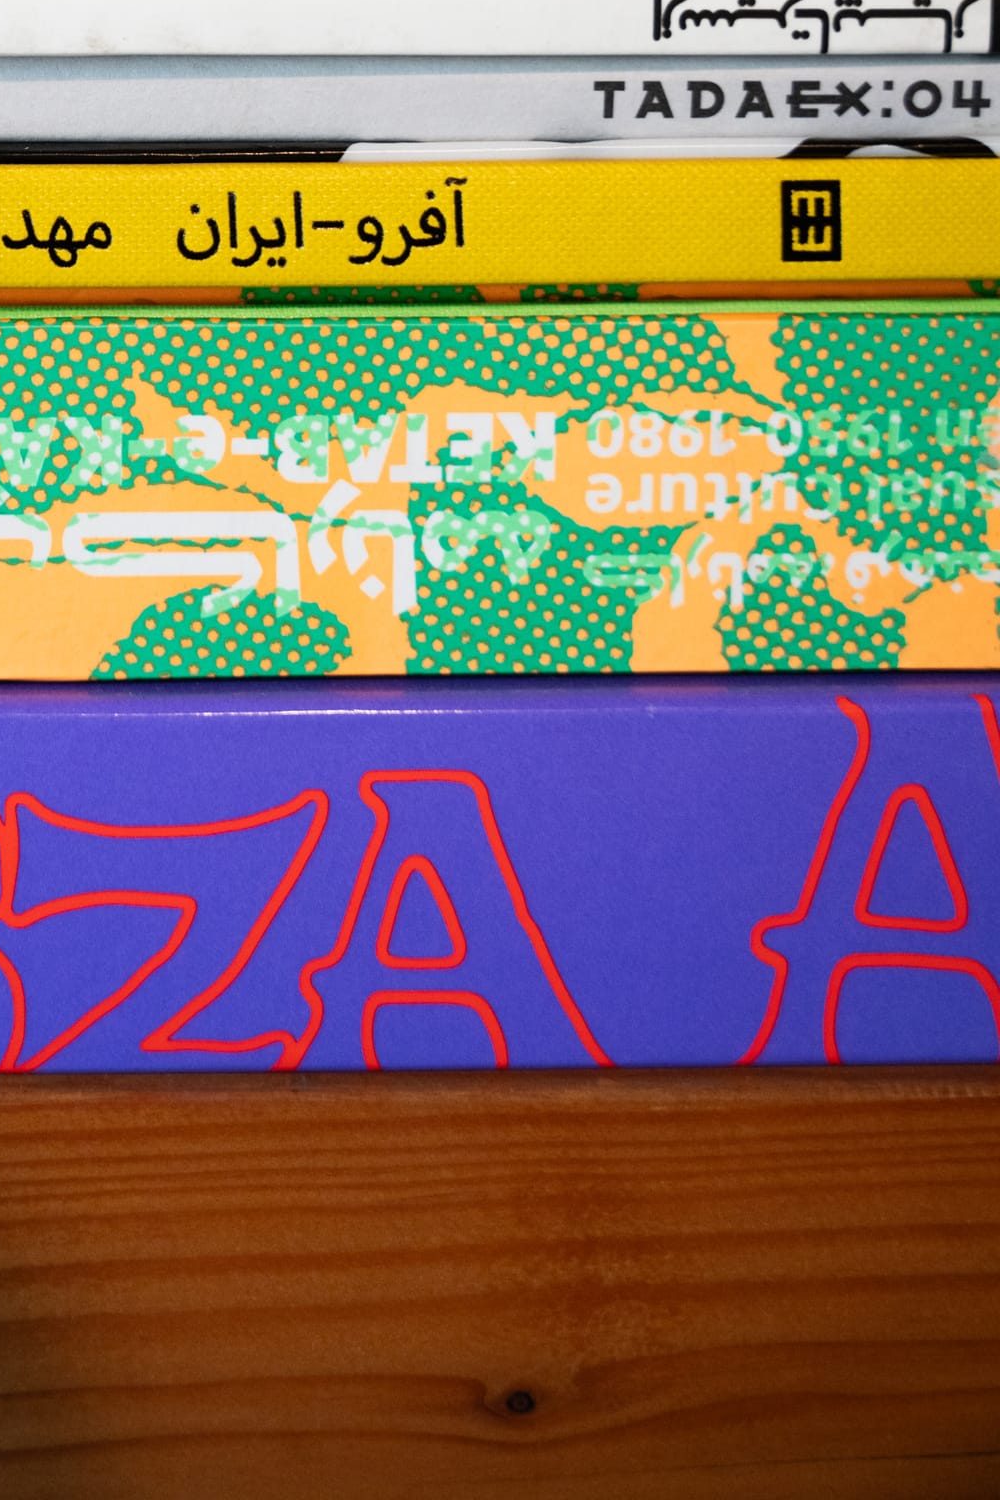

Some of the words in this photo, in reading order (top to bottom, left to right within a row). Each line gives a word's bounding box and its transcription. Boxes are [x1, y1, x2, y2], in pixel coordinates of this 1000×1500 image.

[586, 408, 914, 459] 1950-1980
[584, 470, 843, 525] Culture
[62, 478, 551, 619] کارنامه
